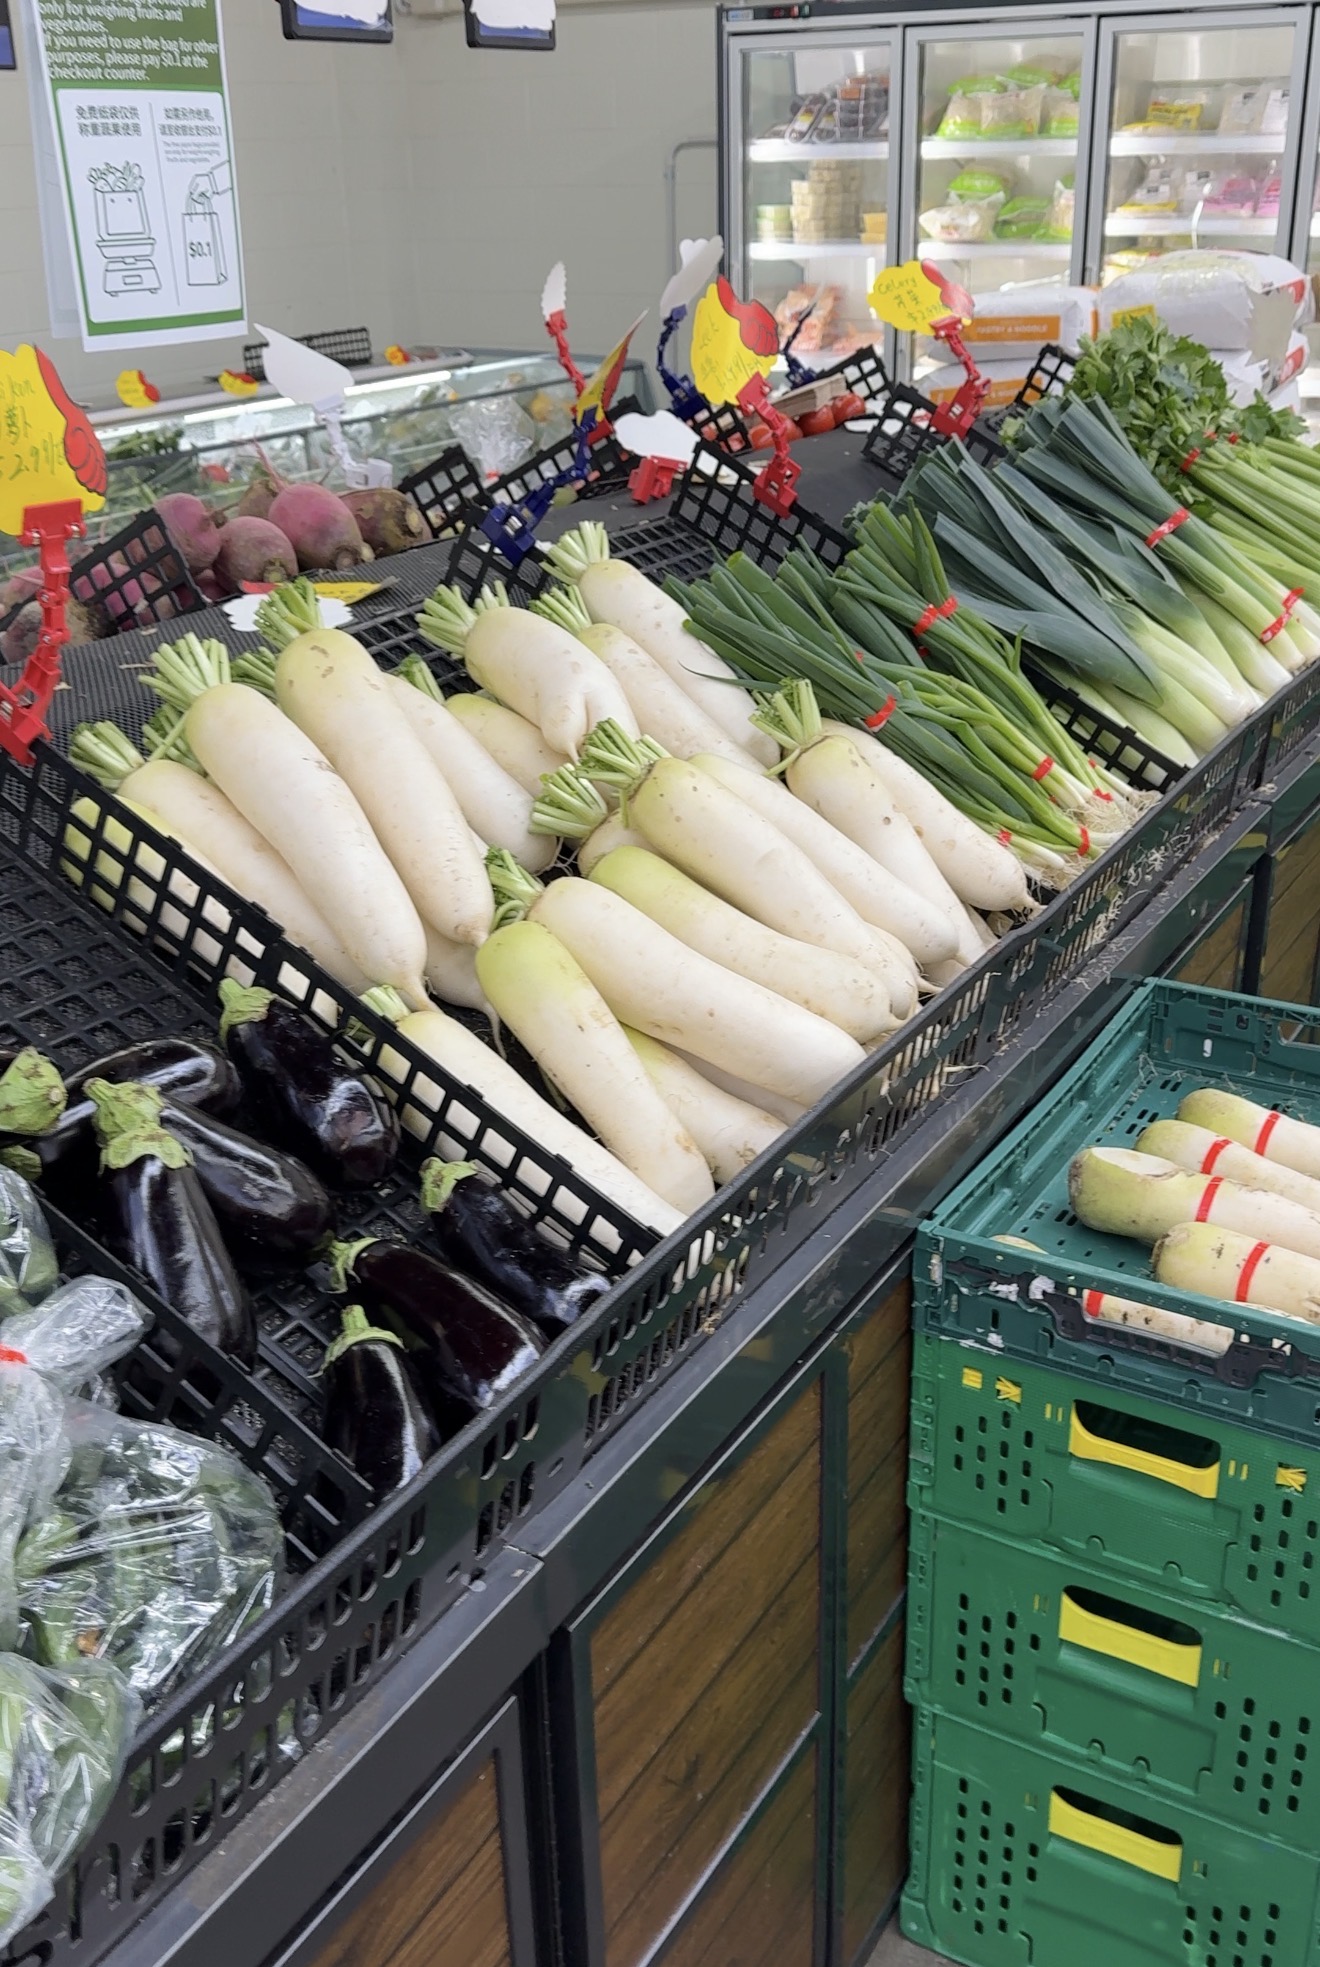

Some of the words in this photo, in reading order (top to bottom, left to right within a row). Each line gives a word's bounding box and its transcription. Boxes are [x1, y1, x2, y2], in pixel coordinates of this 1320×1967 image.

[40, 0, 65, 18] only
[66, 0, 84, 16] for
[84, 2, 138, 22] weighing
[137, 4, 164, 20] fruits
[164, 7, 184, 22] and
[41, 16, 108, 35] vegetables.
[52, 35, 77, 50] you
[77, 33, 108, 49] need
[108, 34, 122, 49] to
[121, 37, 142, 50] use
[141, 35, 160, 51] the
[160, 36, 180, 54] bag
[178, 37, 193, 53] for
[192, 38, 219, 54] other
[47, 51, 105, 67] purposes,
[105, 49, 141, 67] please
[141, 53, 161, 69] pay
[160, 51, 182, 68] $0.1
[181, 54, 193, 67] at
[191, 53, 208, 69] the
[48, 64, 103, 79] checkout
[104, 67, 150, 81] counter.
[188, 242, 212, 259] $0.1
